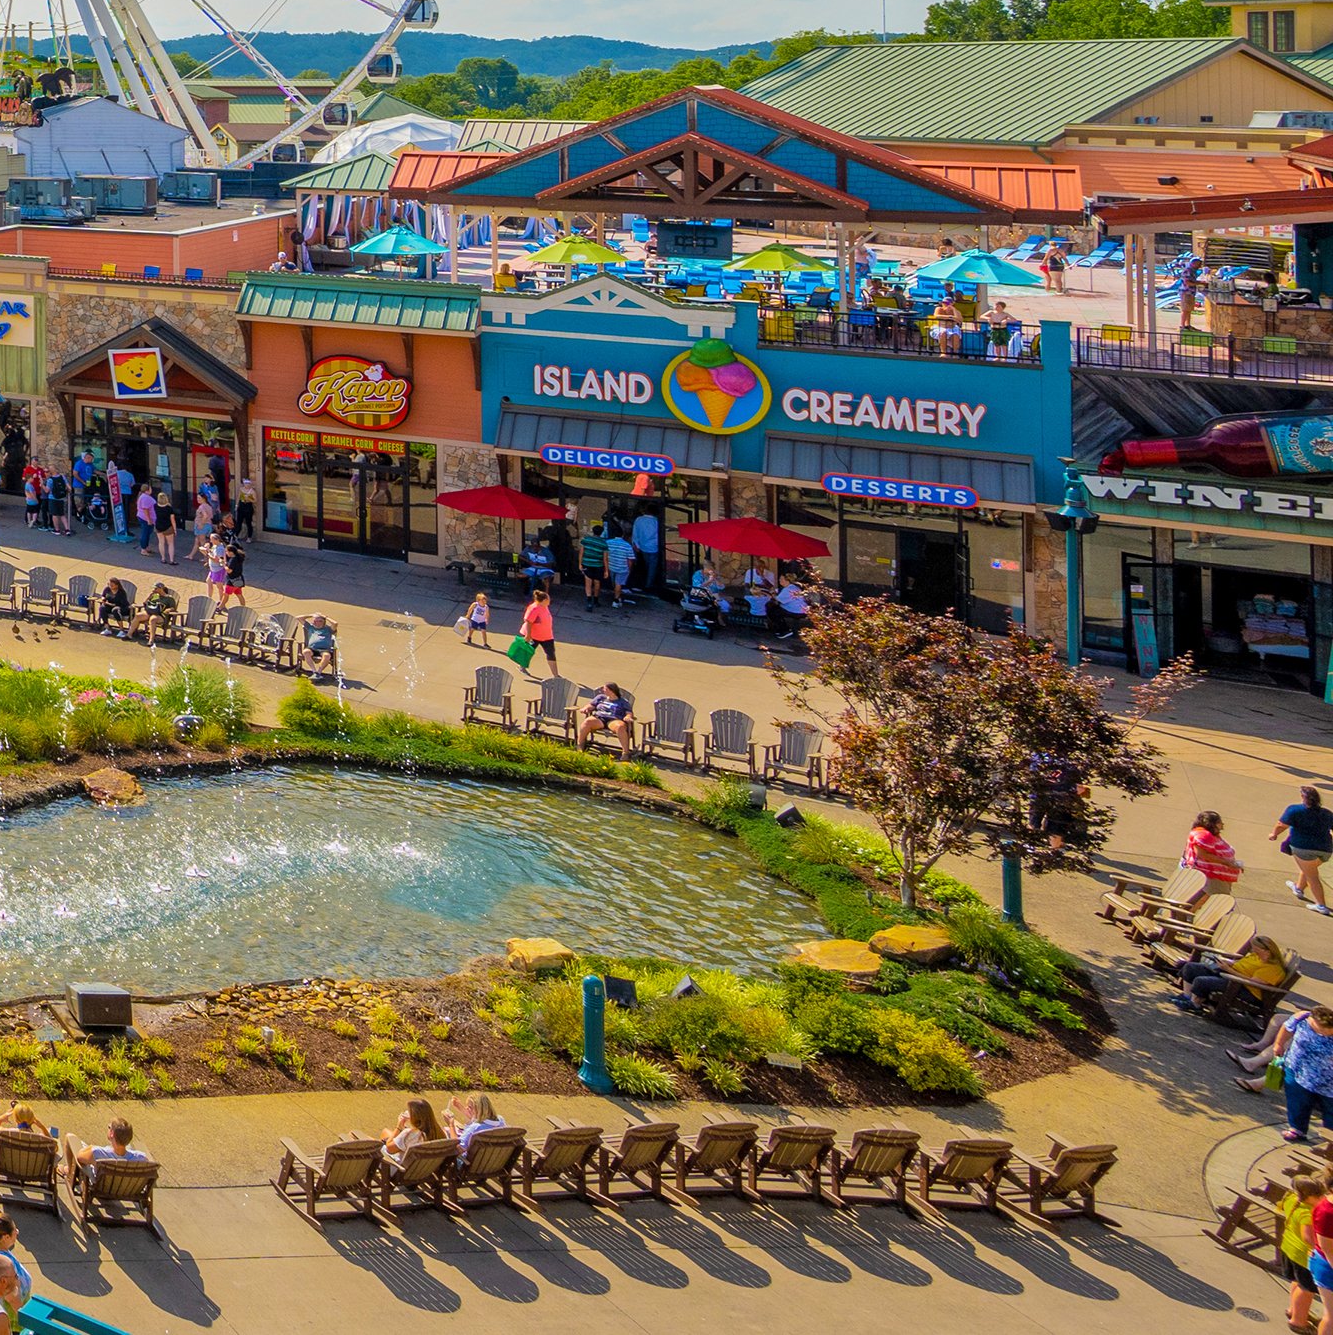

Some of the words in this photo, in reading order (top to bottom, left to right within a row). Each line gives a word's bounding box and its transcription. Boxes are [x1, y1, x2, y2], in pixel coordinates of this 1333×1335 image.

[299, 371, 405, 415] Kapop
[534, 364, 653, 404] ISLAND
[782, 387, 987, 438] CREAMERY
[271, 429, 295, 440] KETTLE
[296, 432, 314, 443] CORN
[323, 434, 354, 447] CARAMEL
[355, 440, 374, 450] CORN
[378, 441, 404, 453] CHEESE
[548, 448, 666, 473] DELICIOUS
[831, 477, 968, 505] DESSERTS
[1081, 474, 1333, 520] WINE
